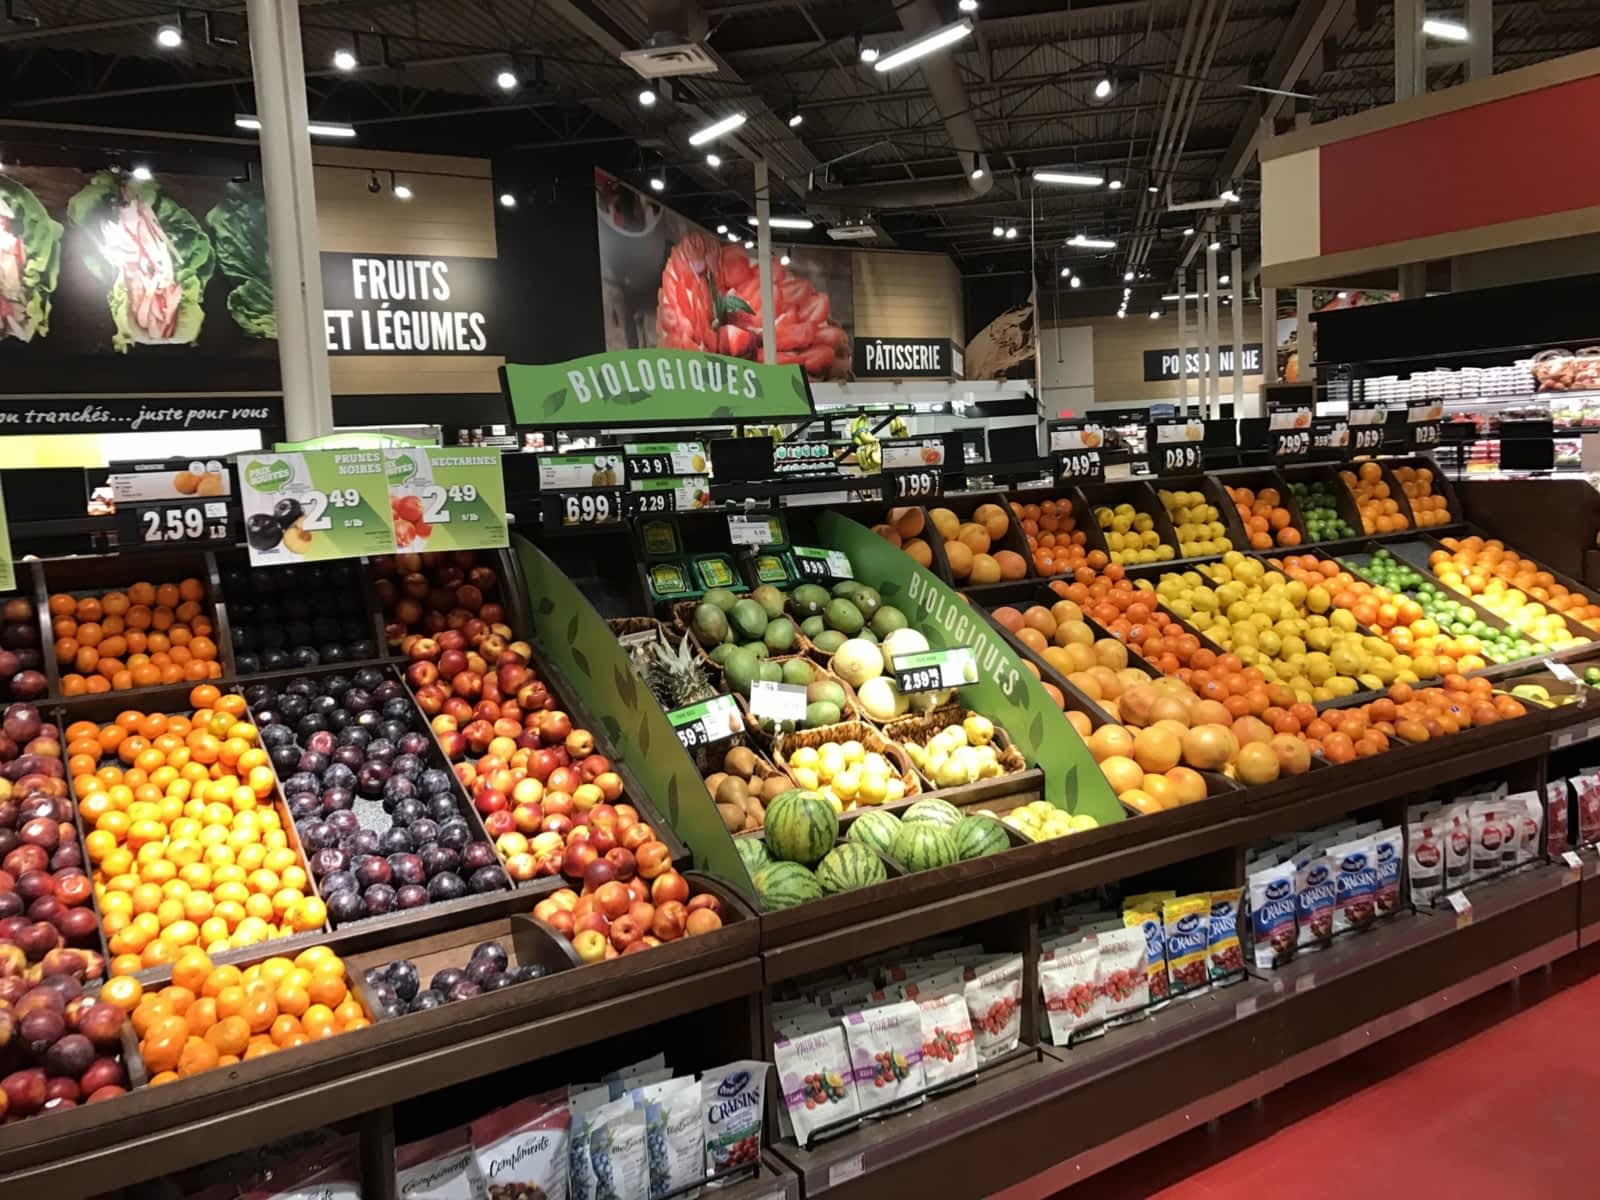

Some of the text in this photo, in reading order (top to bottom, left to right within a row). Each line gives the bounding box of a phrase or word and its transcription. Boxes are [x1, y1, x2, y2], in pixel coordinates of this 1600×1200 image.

[352, 258, 450, 301] FRUITS
[323, 302, 487, 351] ET LÉGUMES
[865, 340, 941, 370] PÂTISSERIE
[1162, 350, 1260, 375] POSSNRIE
[567, 357, 758, 404] BIOLOGIQUES
[131, 405, 183, 430] juste
[184, 408, 228, 427] pour
[231, 406, 269, 419] vous
[335, 453, 381, 464] PRUNES
[338, 463, 382, 475] NOIRES
[431, 456, 497, 467] NECTARINES
[908, 571, 1020, 695] BIOLOGIQUES
[489, 1135, 551, 1178] Compliments
